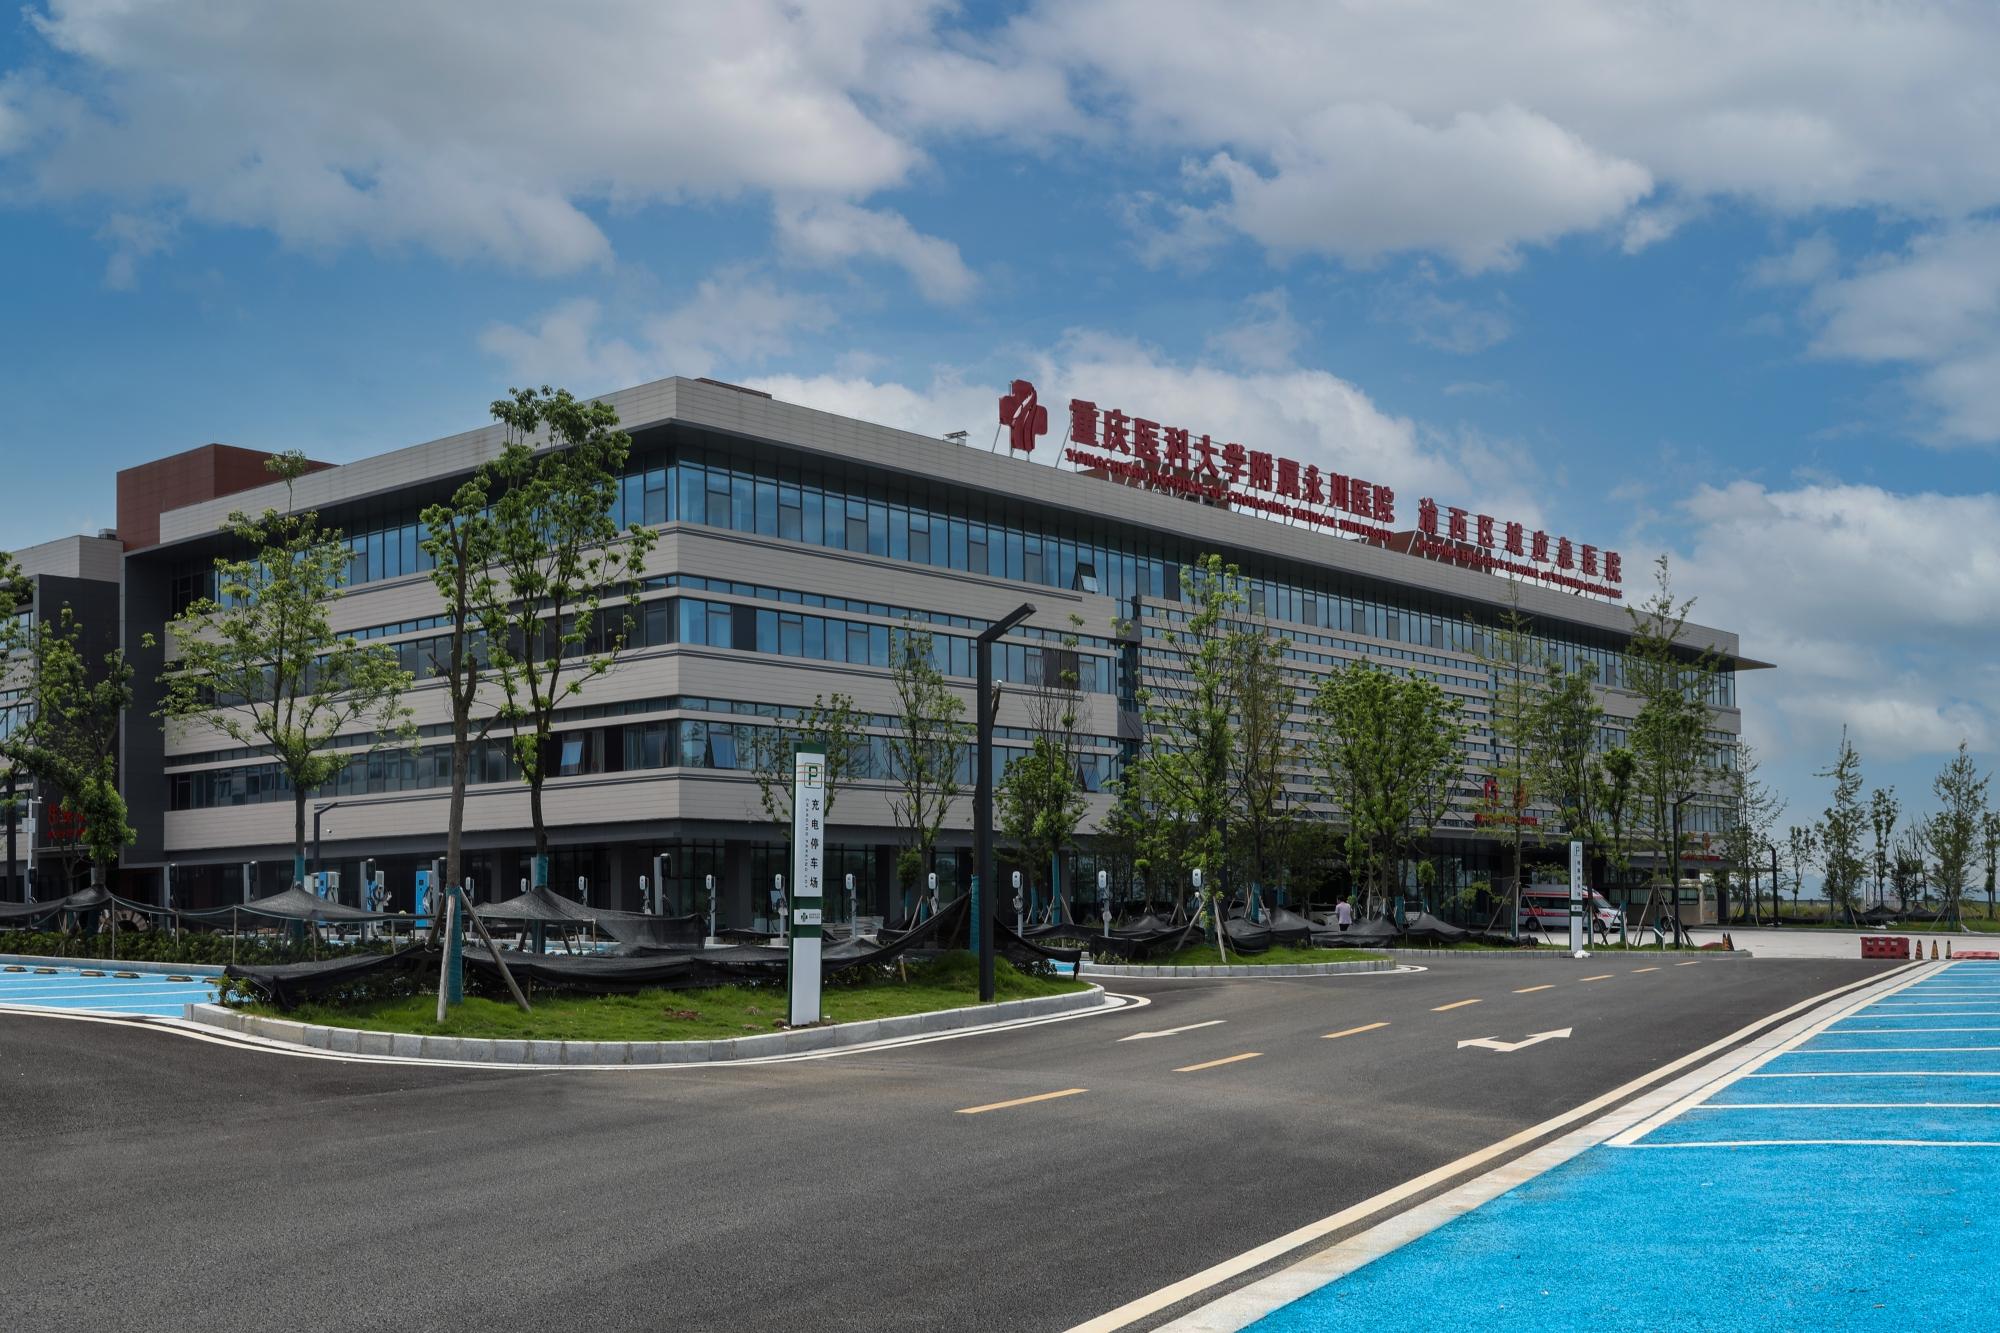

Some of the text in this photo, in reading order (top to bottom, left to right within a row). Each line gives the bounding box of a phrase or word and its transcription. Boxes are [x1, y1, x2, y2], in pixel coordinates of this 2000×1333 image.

[1069, 399, 1395, 523] 重庆医科大学附属永川医院
[1227, 491, 1291, 516] CHONGQING
[1293, 507, 1336, 528] MEDICAL
[1339, 518, 1393, 541] UNIVERSITY
[1418, 497, 1622, 583] 渝西区域应急医院
[810, 799, 820, 888] 充电停车场
